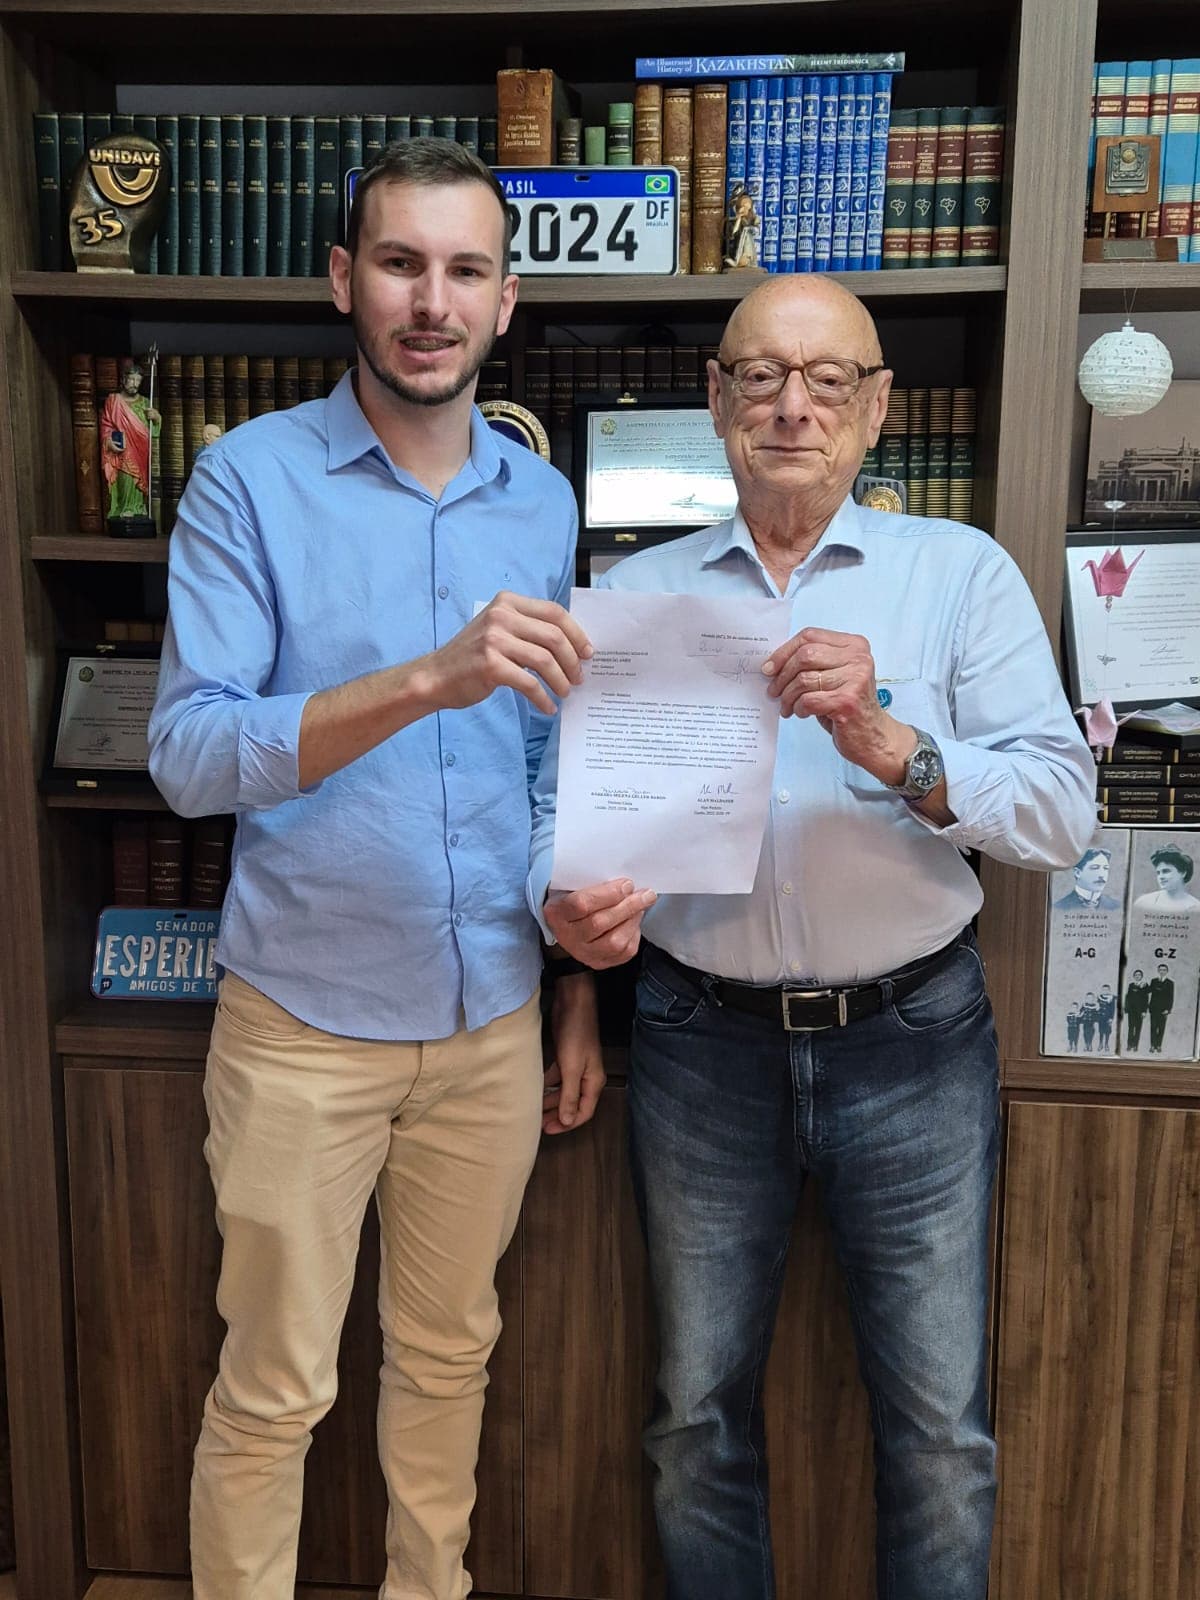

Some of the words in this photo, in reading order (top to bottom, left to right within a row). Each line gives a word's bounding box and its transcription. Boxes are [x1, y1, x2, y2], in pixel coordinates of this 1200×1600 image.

[656, 58, 694, 67] Illustrated
[657, 64, 682, 74] History
[684, 64, 693, 73] of
[695, 57, 796, 75] KAZAKHSTAN
[89, 148, 161, 166] UNIDAVI
[500, 180, 537, 195] ASIL
[645, 200, 670, 221] DF
[77, 209, 123, 245] 35
[155, 920, 216, 933] SENADOR
[1074, 947, 1096, 959] A-G
[1154, 947, 1177, 959] G-Z
[129, 979, 177, 992] AMIGOS
[182, 981, 200, 993] DE
